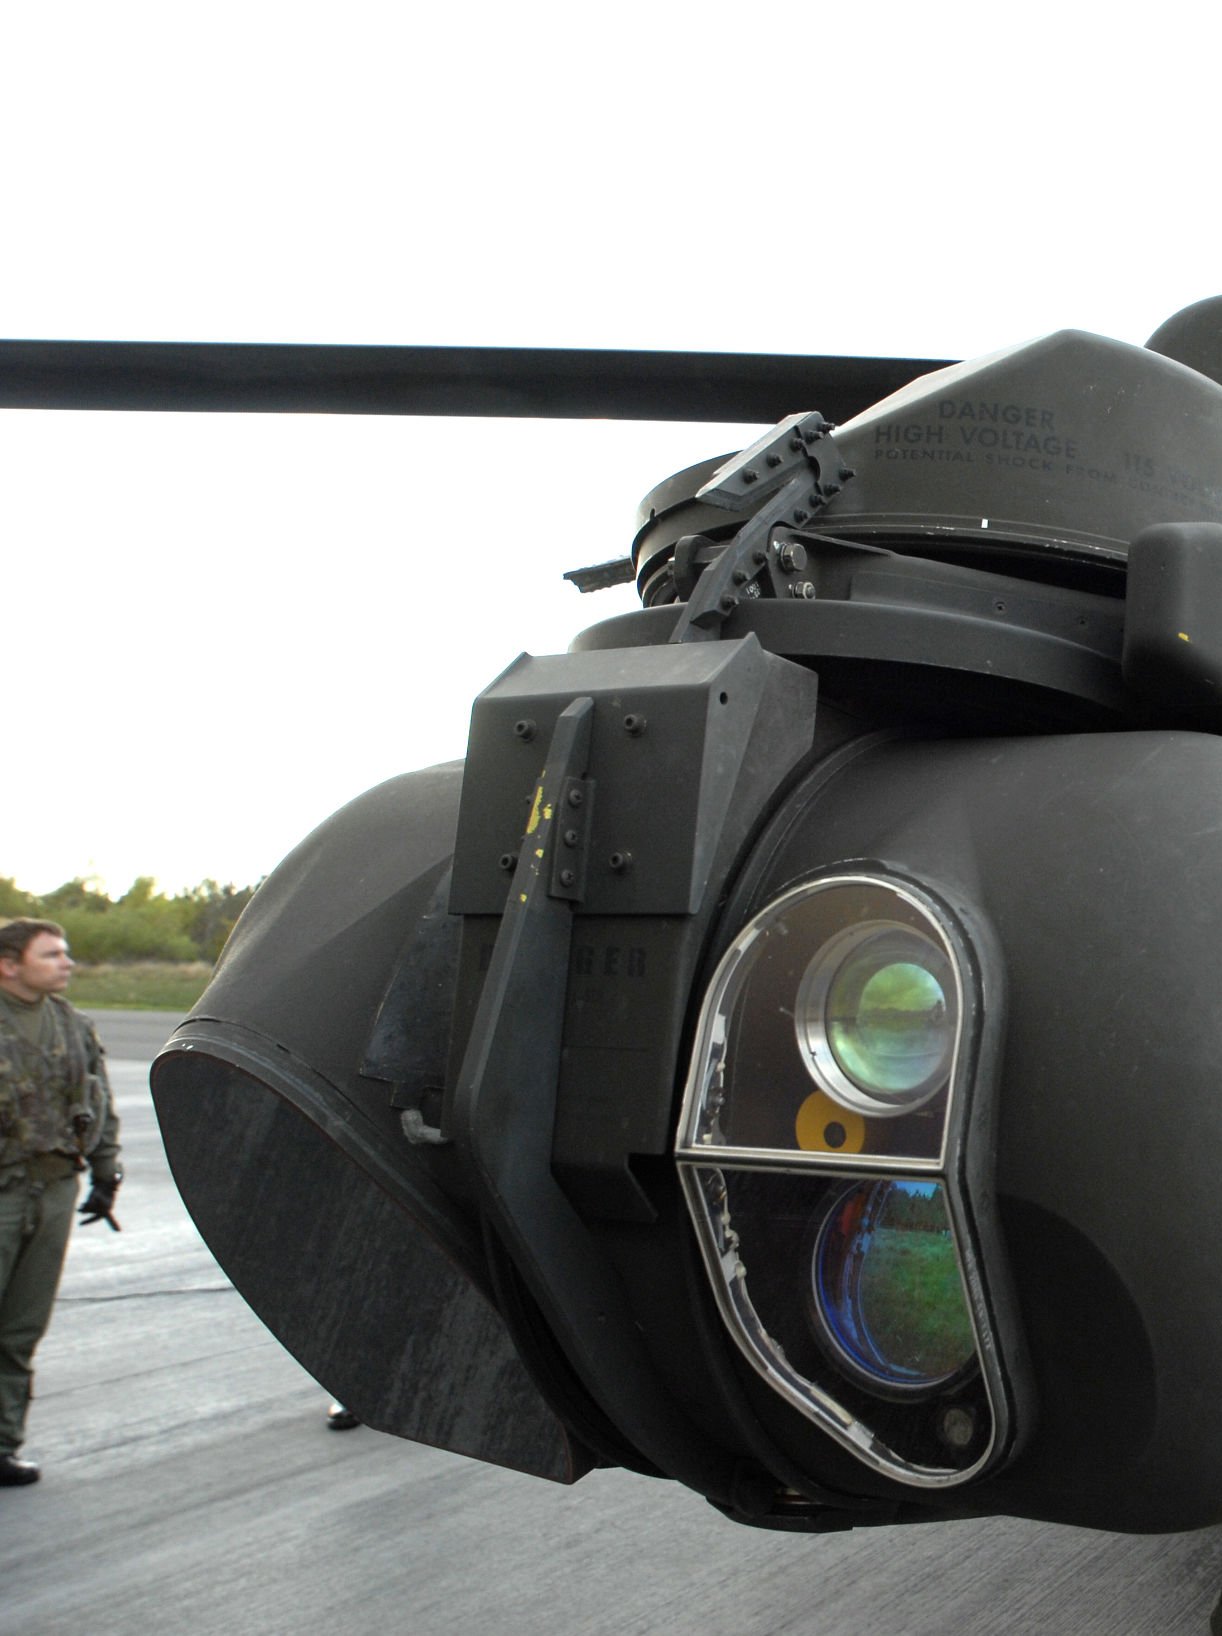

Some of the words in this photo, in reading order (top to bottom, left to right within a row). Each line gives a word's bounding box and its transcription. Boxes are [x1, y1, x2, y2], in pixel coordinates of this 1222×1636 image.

[938, 398, 1055, 431] DANGER
[874, 424, 944, 444] HIGH
[960, 427, 1078, 460] VOLTAGE
[874, 448, 974, 463] POTENTIAL
[985, 452, 1053, 471] SHOCK
[1065, 464, 1118, 484] FROM
